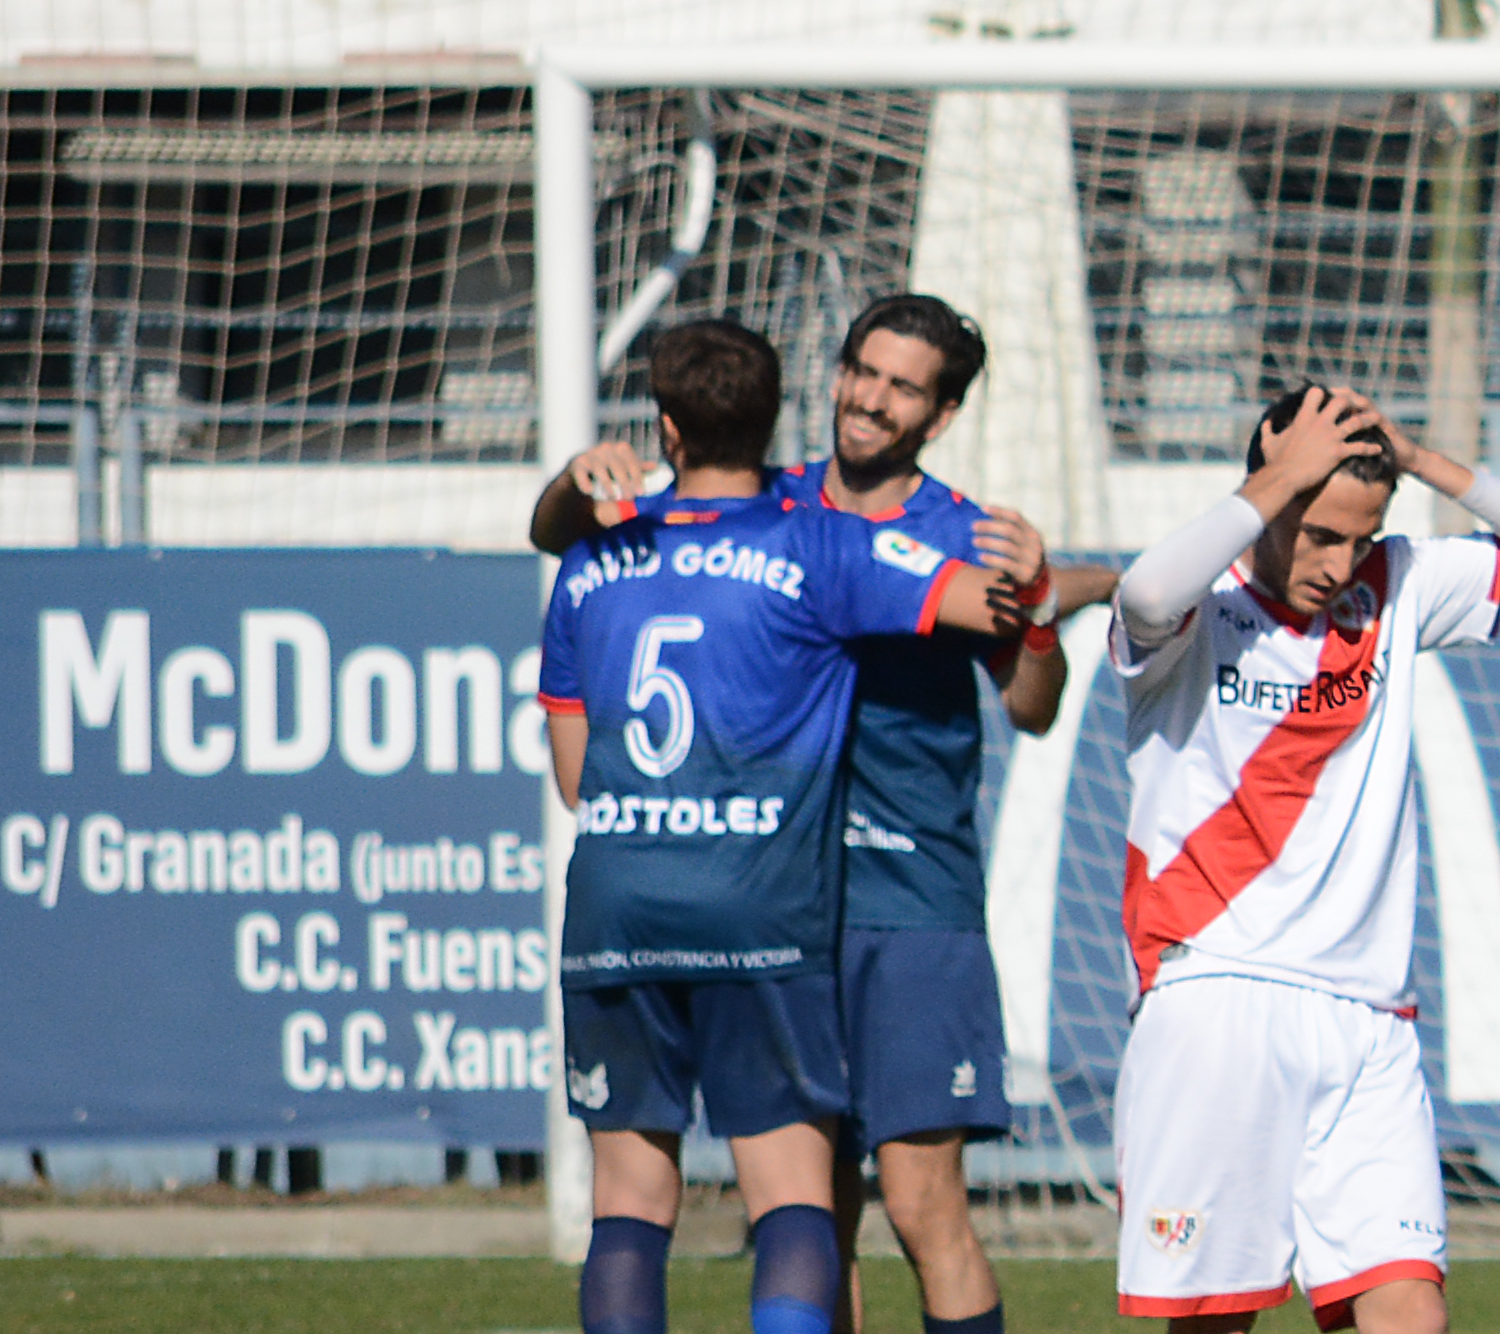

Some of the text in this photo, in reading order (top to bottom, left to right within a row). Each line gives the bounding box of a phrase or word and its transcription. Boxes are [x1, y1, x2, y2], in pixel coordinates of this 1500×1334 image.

[672, 538, 804, 599] GÓMEZ
[625, 616, 704, 778] 5
[1218, 664, 1312, 713] BUFETE
[2, 814, 69, 909] C/
[79, 814, 340, 893] Granada
[351, 832, 484, 903] (junto
[235, 912, 548, 993] C.C. Fuens
[282, 1010, 405, 1092] C.C.
